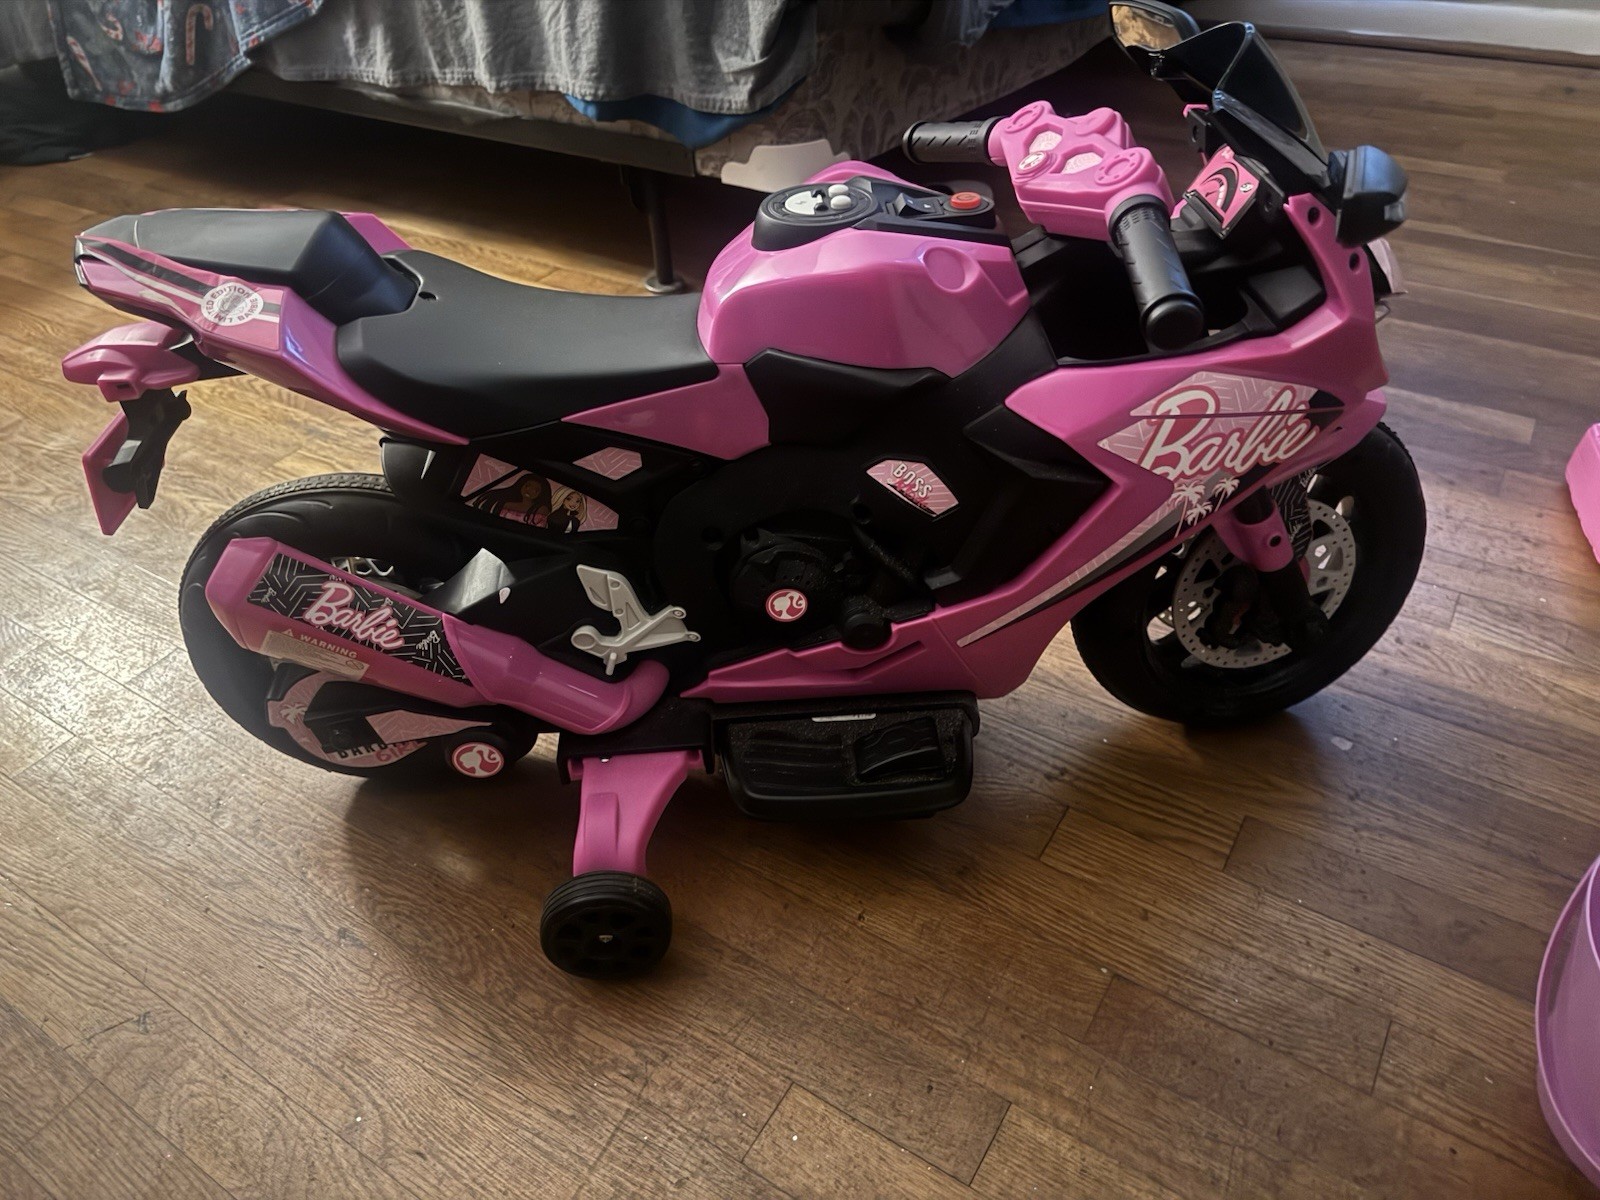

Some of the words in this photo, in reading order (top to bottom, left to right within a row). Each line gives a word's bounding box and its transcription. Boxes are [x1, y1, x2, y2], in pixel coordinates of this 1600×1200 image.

[211, 285, 252, 299] EDITION
[206, 300, 233, 323] LIMITED
[1139, 387, 1318, 480] Barbie
[893, 463, 932, 498] BOSS
[305, 581, 404, 649] Barbie
[301, 634, 357, 658] WARNING
